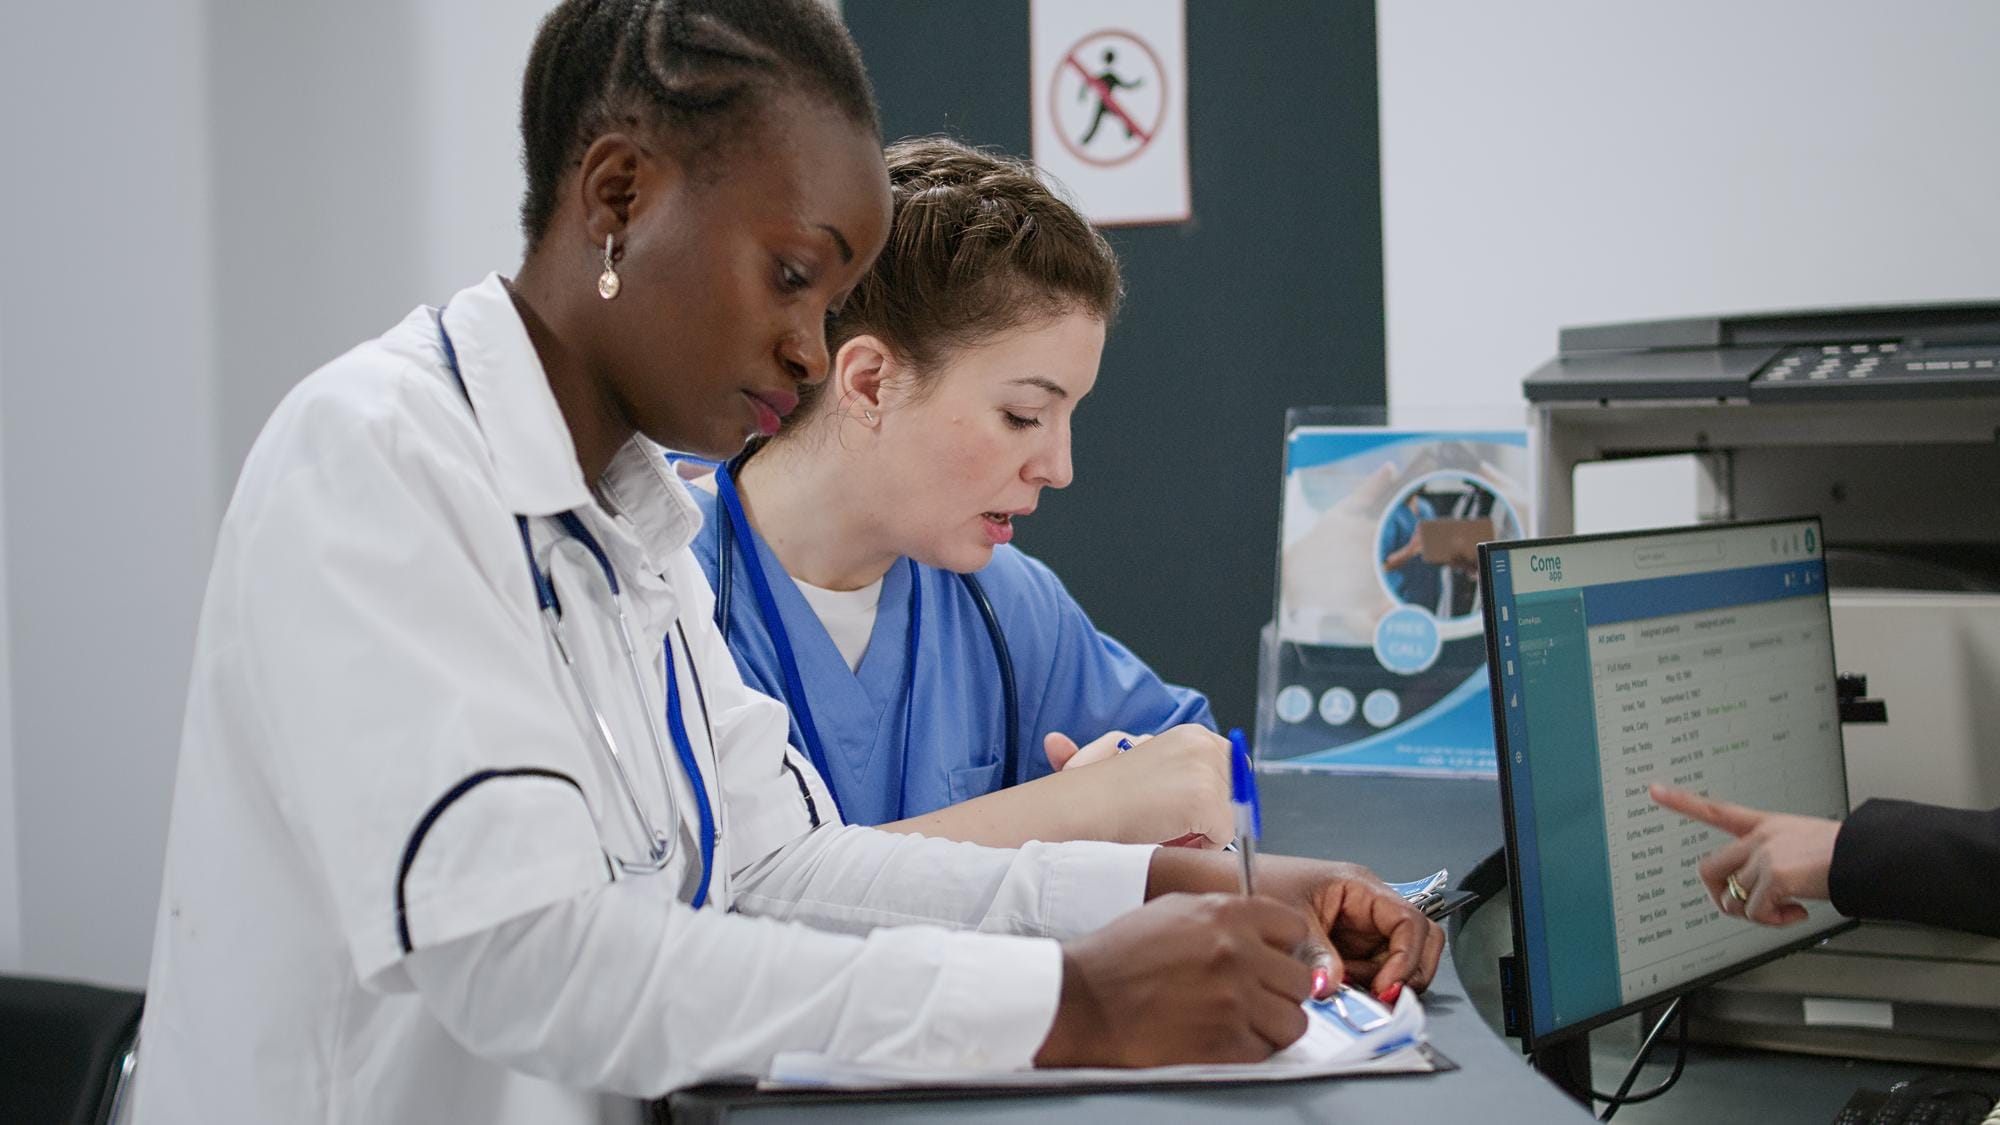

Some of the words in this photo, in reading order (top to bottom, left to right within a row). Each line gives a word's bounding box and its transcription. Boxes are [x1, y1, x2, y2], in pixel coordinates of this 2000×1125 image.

[1530, 555, 1561, 572] Come
[1549, 571, 1562, 581] app
[1386, 622, 1424, 635] FREE
[1606, 634, 1625, 644] patients
[1389, 642, 1424, 656] CALL
